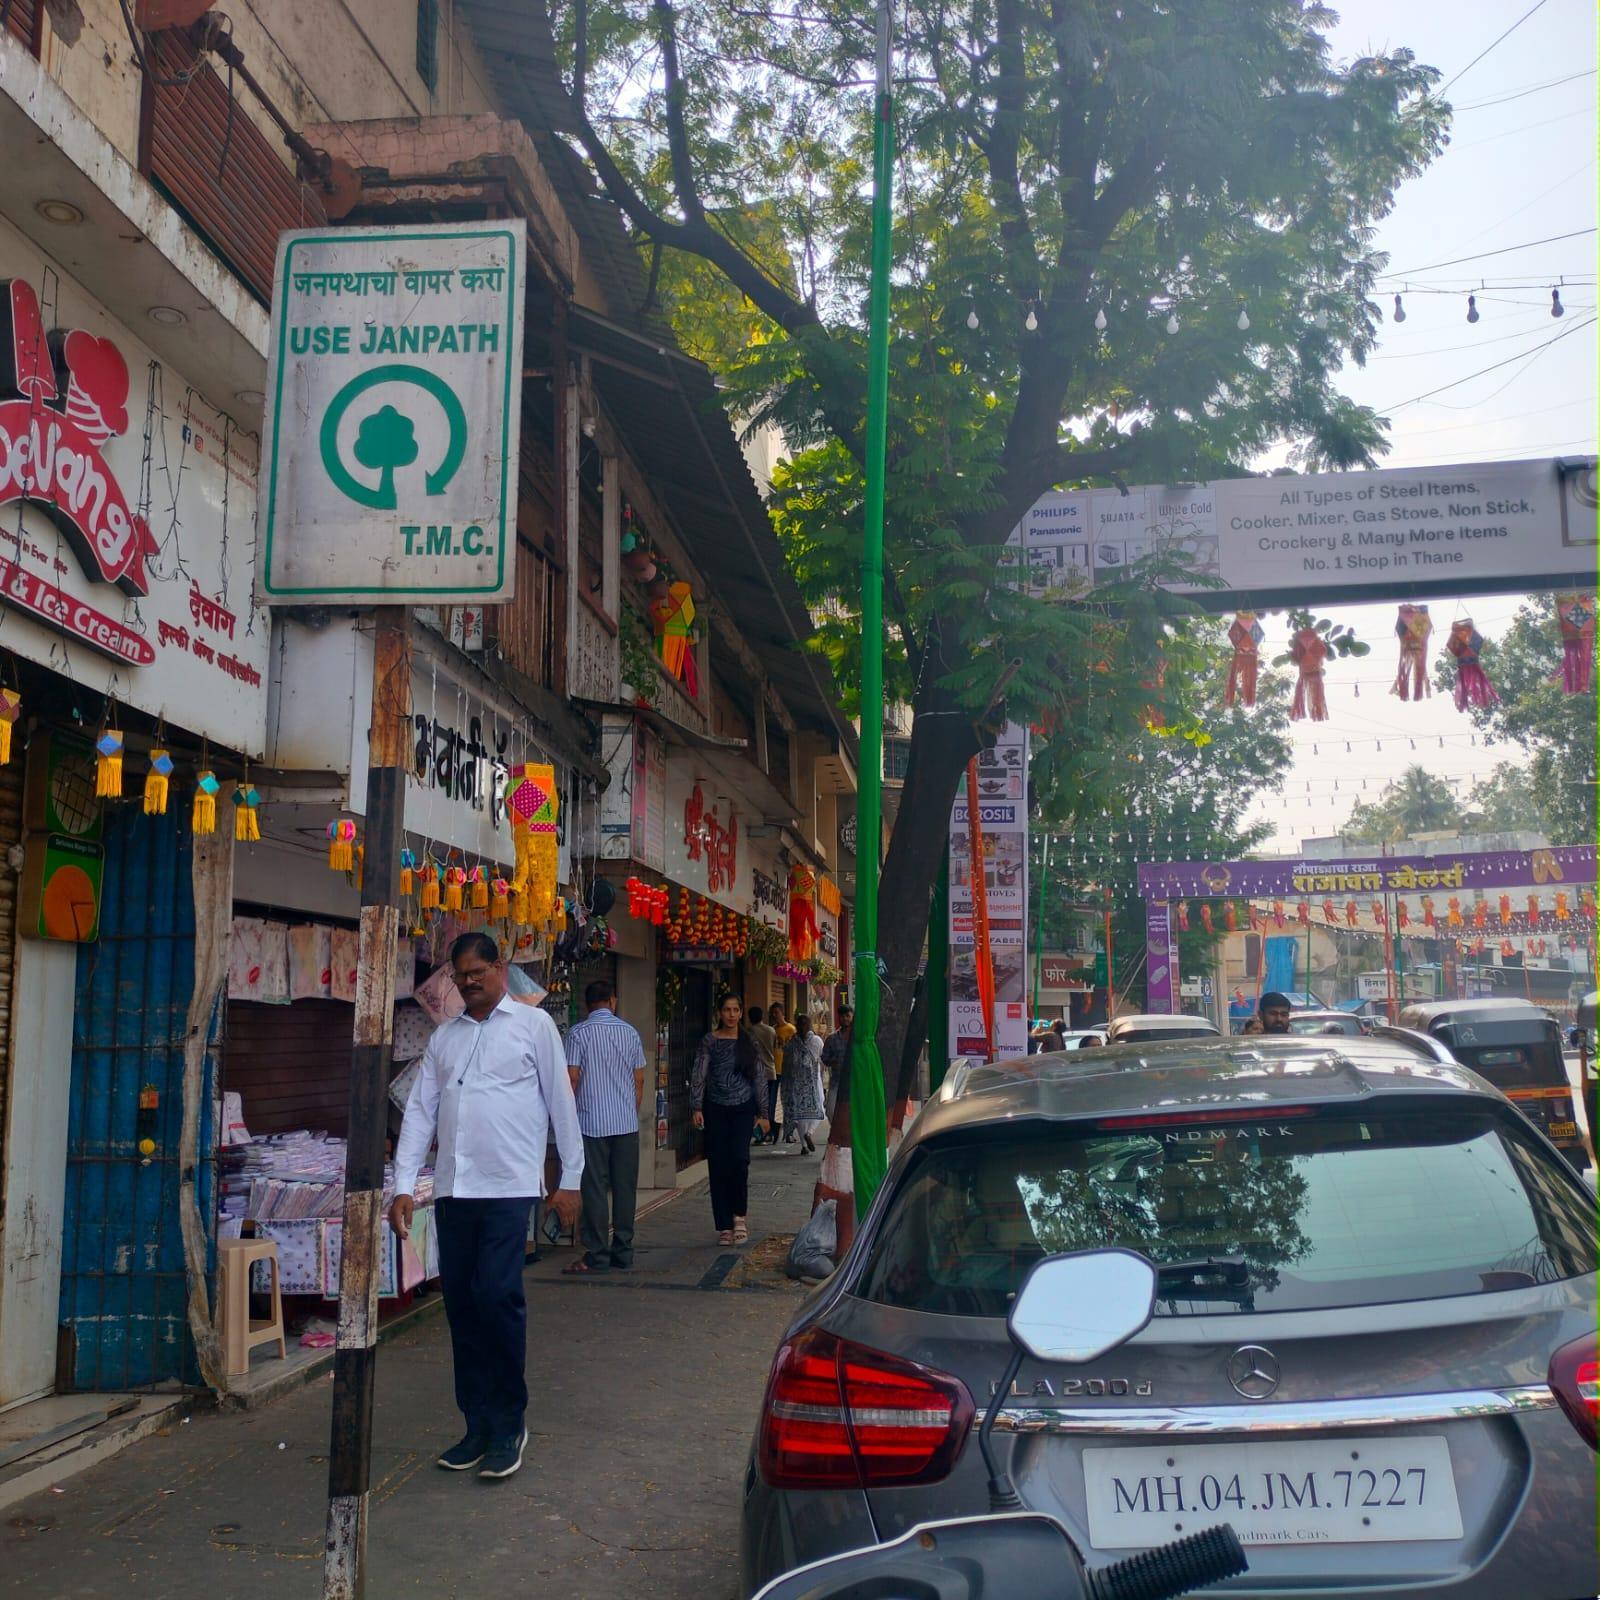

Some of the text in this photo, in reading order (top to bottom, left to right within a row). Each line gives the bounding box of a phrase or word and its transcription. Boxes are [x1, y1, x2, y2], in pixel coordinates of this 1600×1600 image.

[293, 267, 505, 297] जनपथाचा वापर करा
[290, 323, 500, 355] USE JANPATH
[1280, 491, 1300, 505] All
[1303, 489, 1353, 507] Types
[1357, 486, 1375, 501] of
[1379, 482, 1424, 499] Steel
[1032, 506, 1077, 519] PHILIPS
[1100, 511, 1135, 524] SUJATA
[1352, 509, 1386, 524] Gas
[1448, 503, 1481, 517] Non
[399, 525, 494, 556] T.M.C.
[1029, 525, 1082, 537] Panasonic
[1258, 525, 1508, 551] Crockery & Many More Items
[1303, 550, 1464, 571] No. 1 Shop in Thane
[189, 578, 237, 641] देवांग
[33, 584, 70, 621] Ice
[73, 606, 141, 660] Cream
[1292, 873, 1382, 892] राजावत
[1128, 1125, 1297, 1146] LANDMARK
[1063, 1378, 1129, 1397] 200
[1113, 1467, 1427, 1515] MH.04.JM.7227
[1237, 1527, 1329, 1541] ndmark Cars
